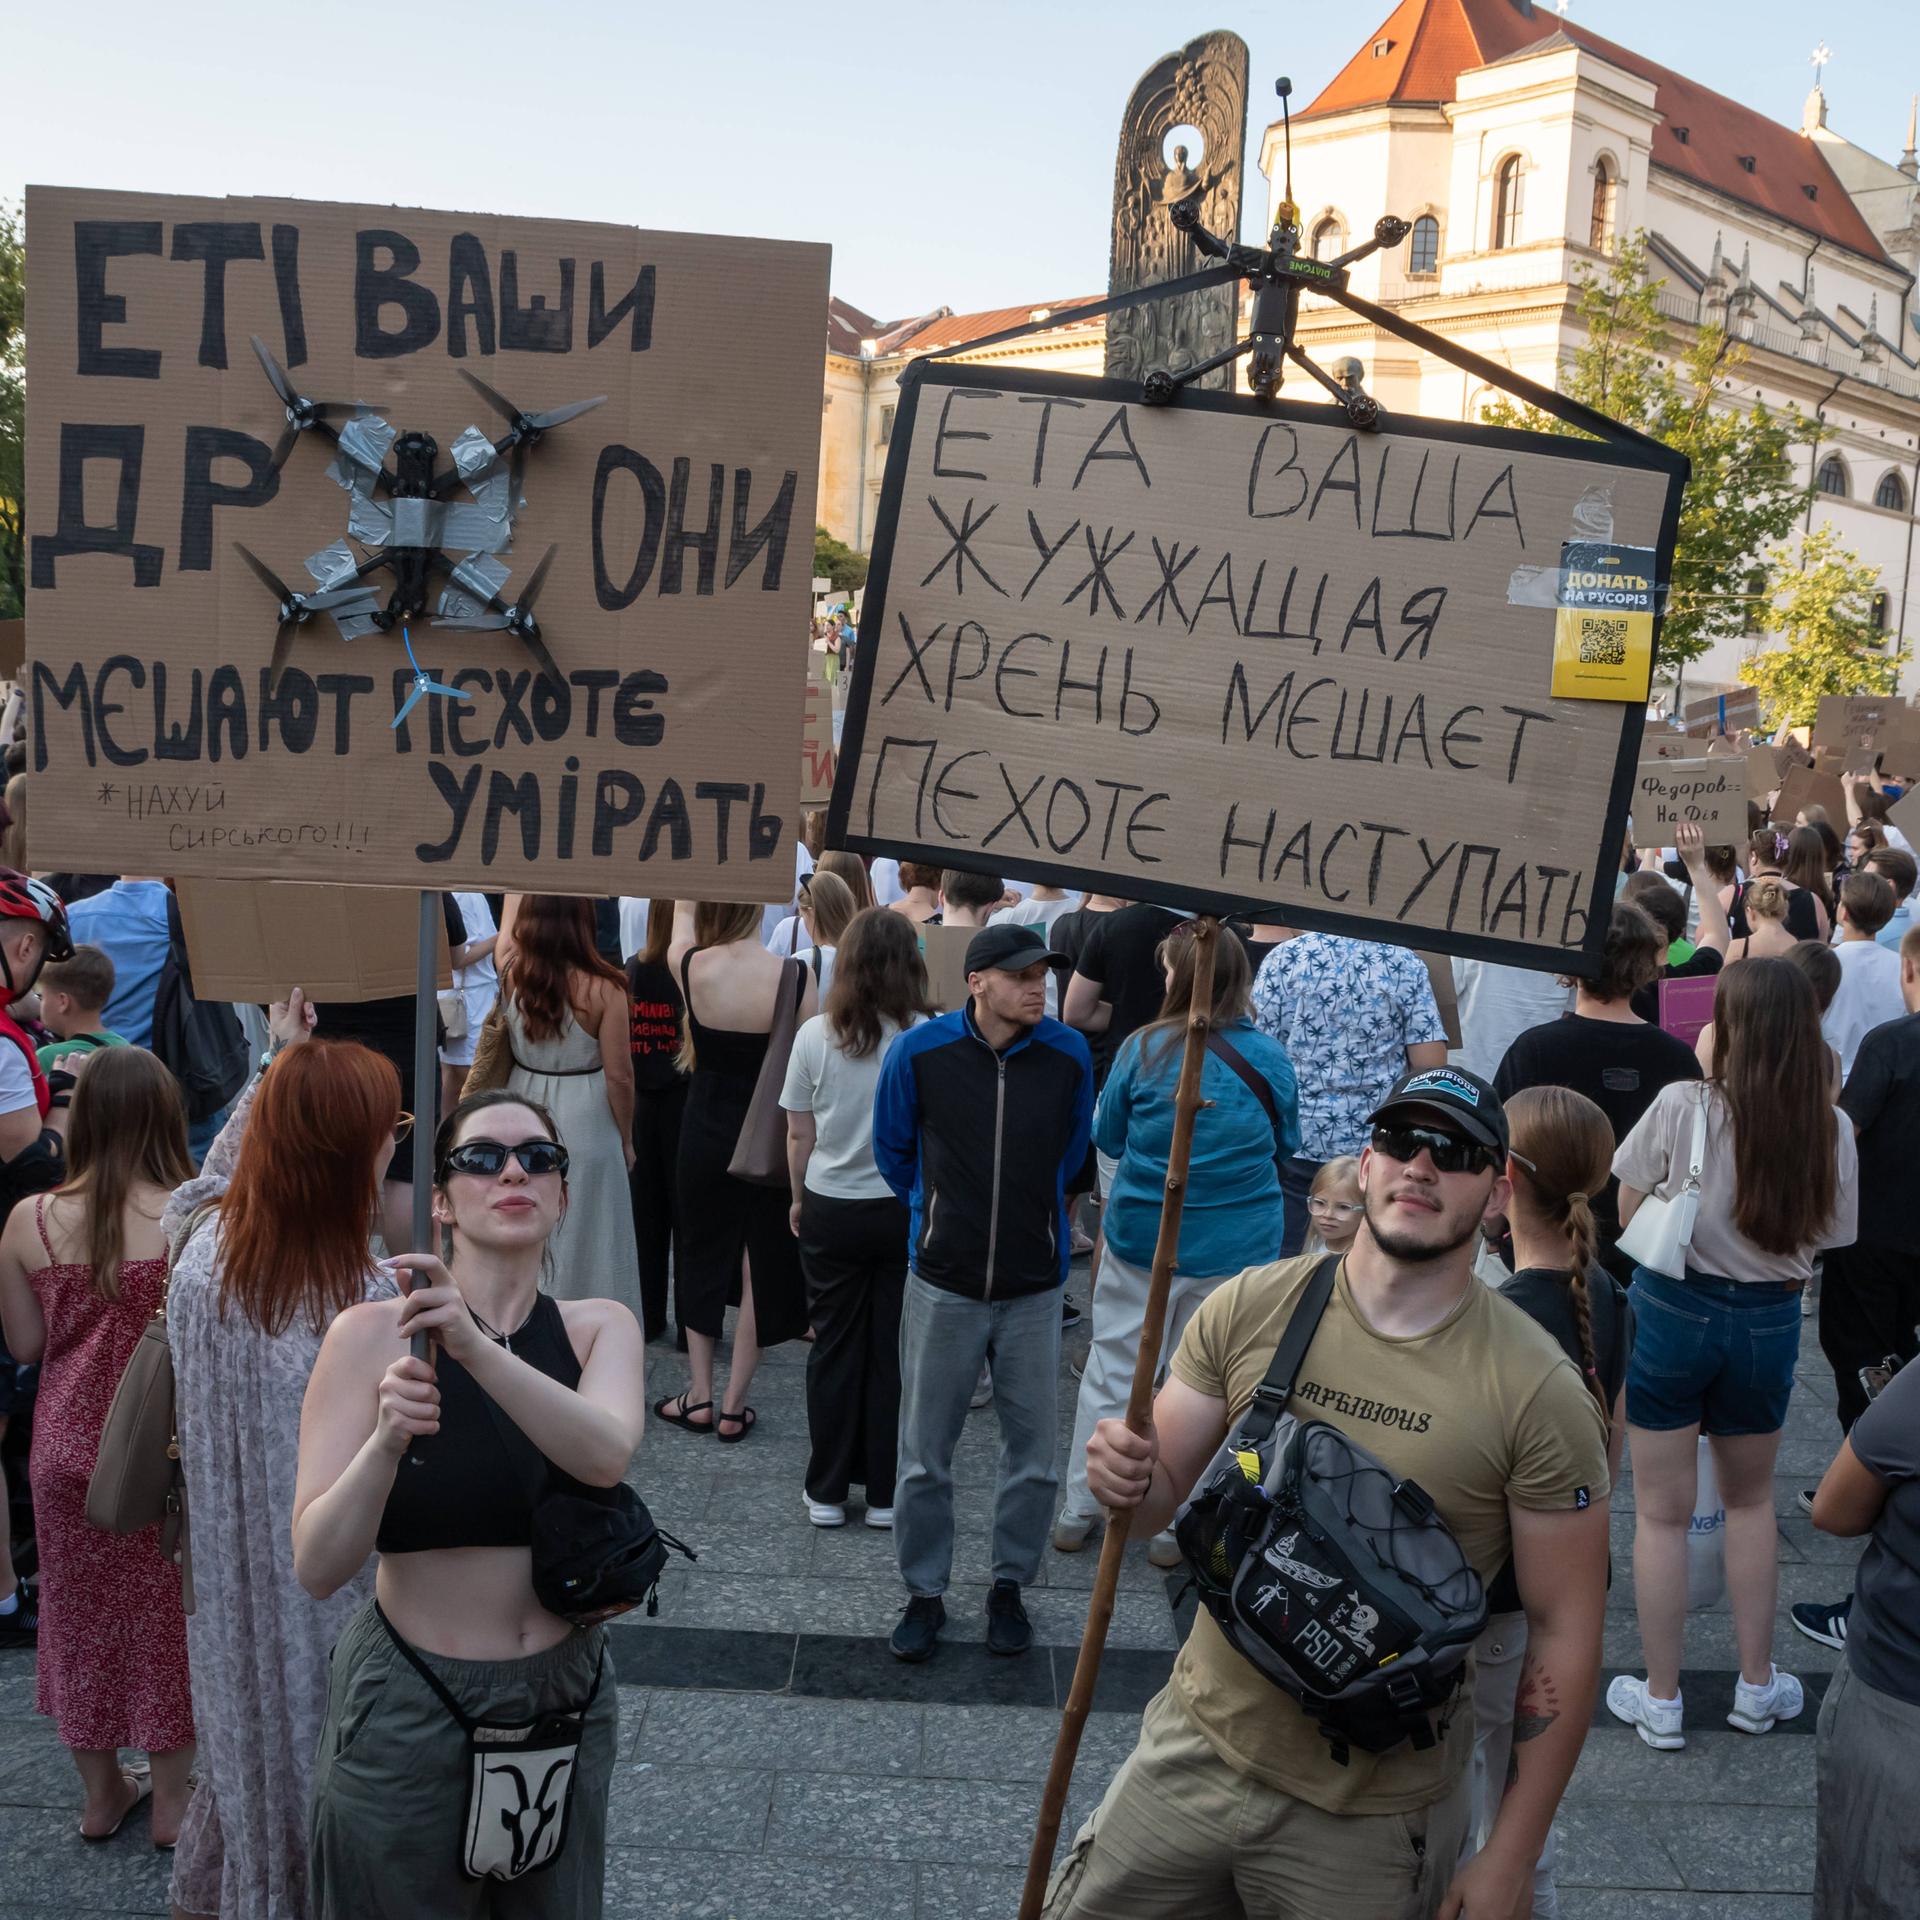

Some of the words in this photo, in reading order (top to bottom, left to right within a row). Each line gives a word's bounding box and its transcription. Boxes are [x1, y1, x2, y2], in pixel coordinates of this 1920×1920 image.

[74, 221, 307, 379] ЕТІ
[355, 229, 656, 358] ВАШИ
[933, 388, 1151, 490] ЕТА
[1249, 423, 1525, 549] ВАША
[920, 495, 1448, 661] ЖУЖЖАЩАЯ
[1565, 591, 1585, 601] НА
[1588, 592, 1648, 605] РУСОРІЗ
[1566, 572, 1648, 591] ДОНАТЬ
[1657, 805, 1679, 823] На
[1684, 805, 1719, 821] Дія
[1219, 801, 1589, 947] НАСТУПАТЬ
[1296, 1381, 1433, 1433] MPHIBIOUS
